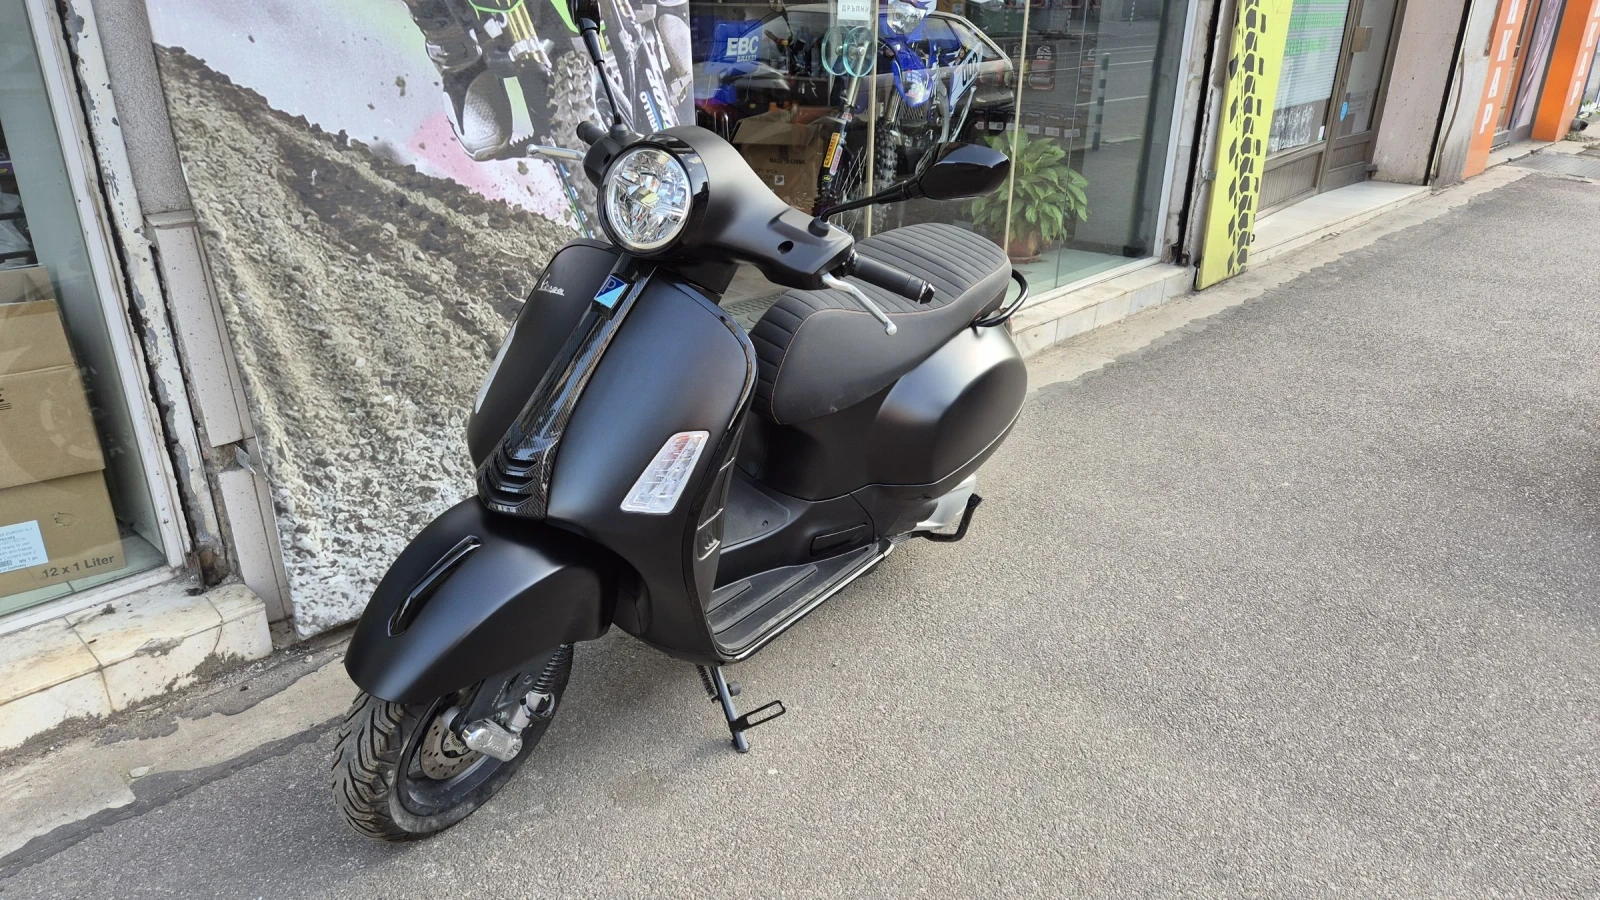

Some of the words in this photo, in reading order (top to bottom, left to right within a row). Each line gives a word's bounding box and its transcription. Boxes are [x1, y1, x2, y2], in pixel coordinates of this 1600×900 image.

[841, 4, 869, 12] ДРЪПНИ
[726, 36, 759, 56] EBC
[538, 273, 565, 296] Vespa
[42, 567, 59, 578] 12
[61, 566, 70, 575] x
[73, 561, 80, 571] 1
[84, 555, 115, 569] Liter
